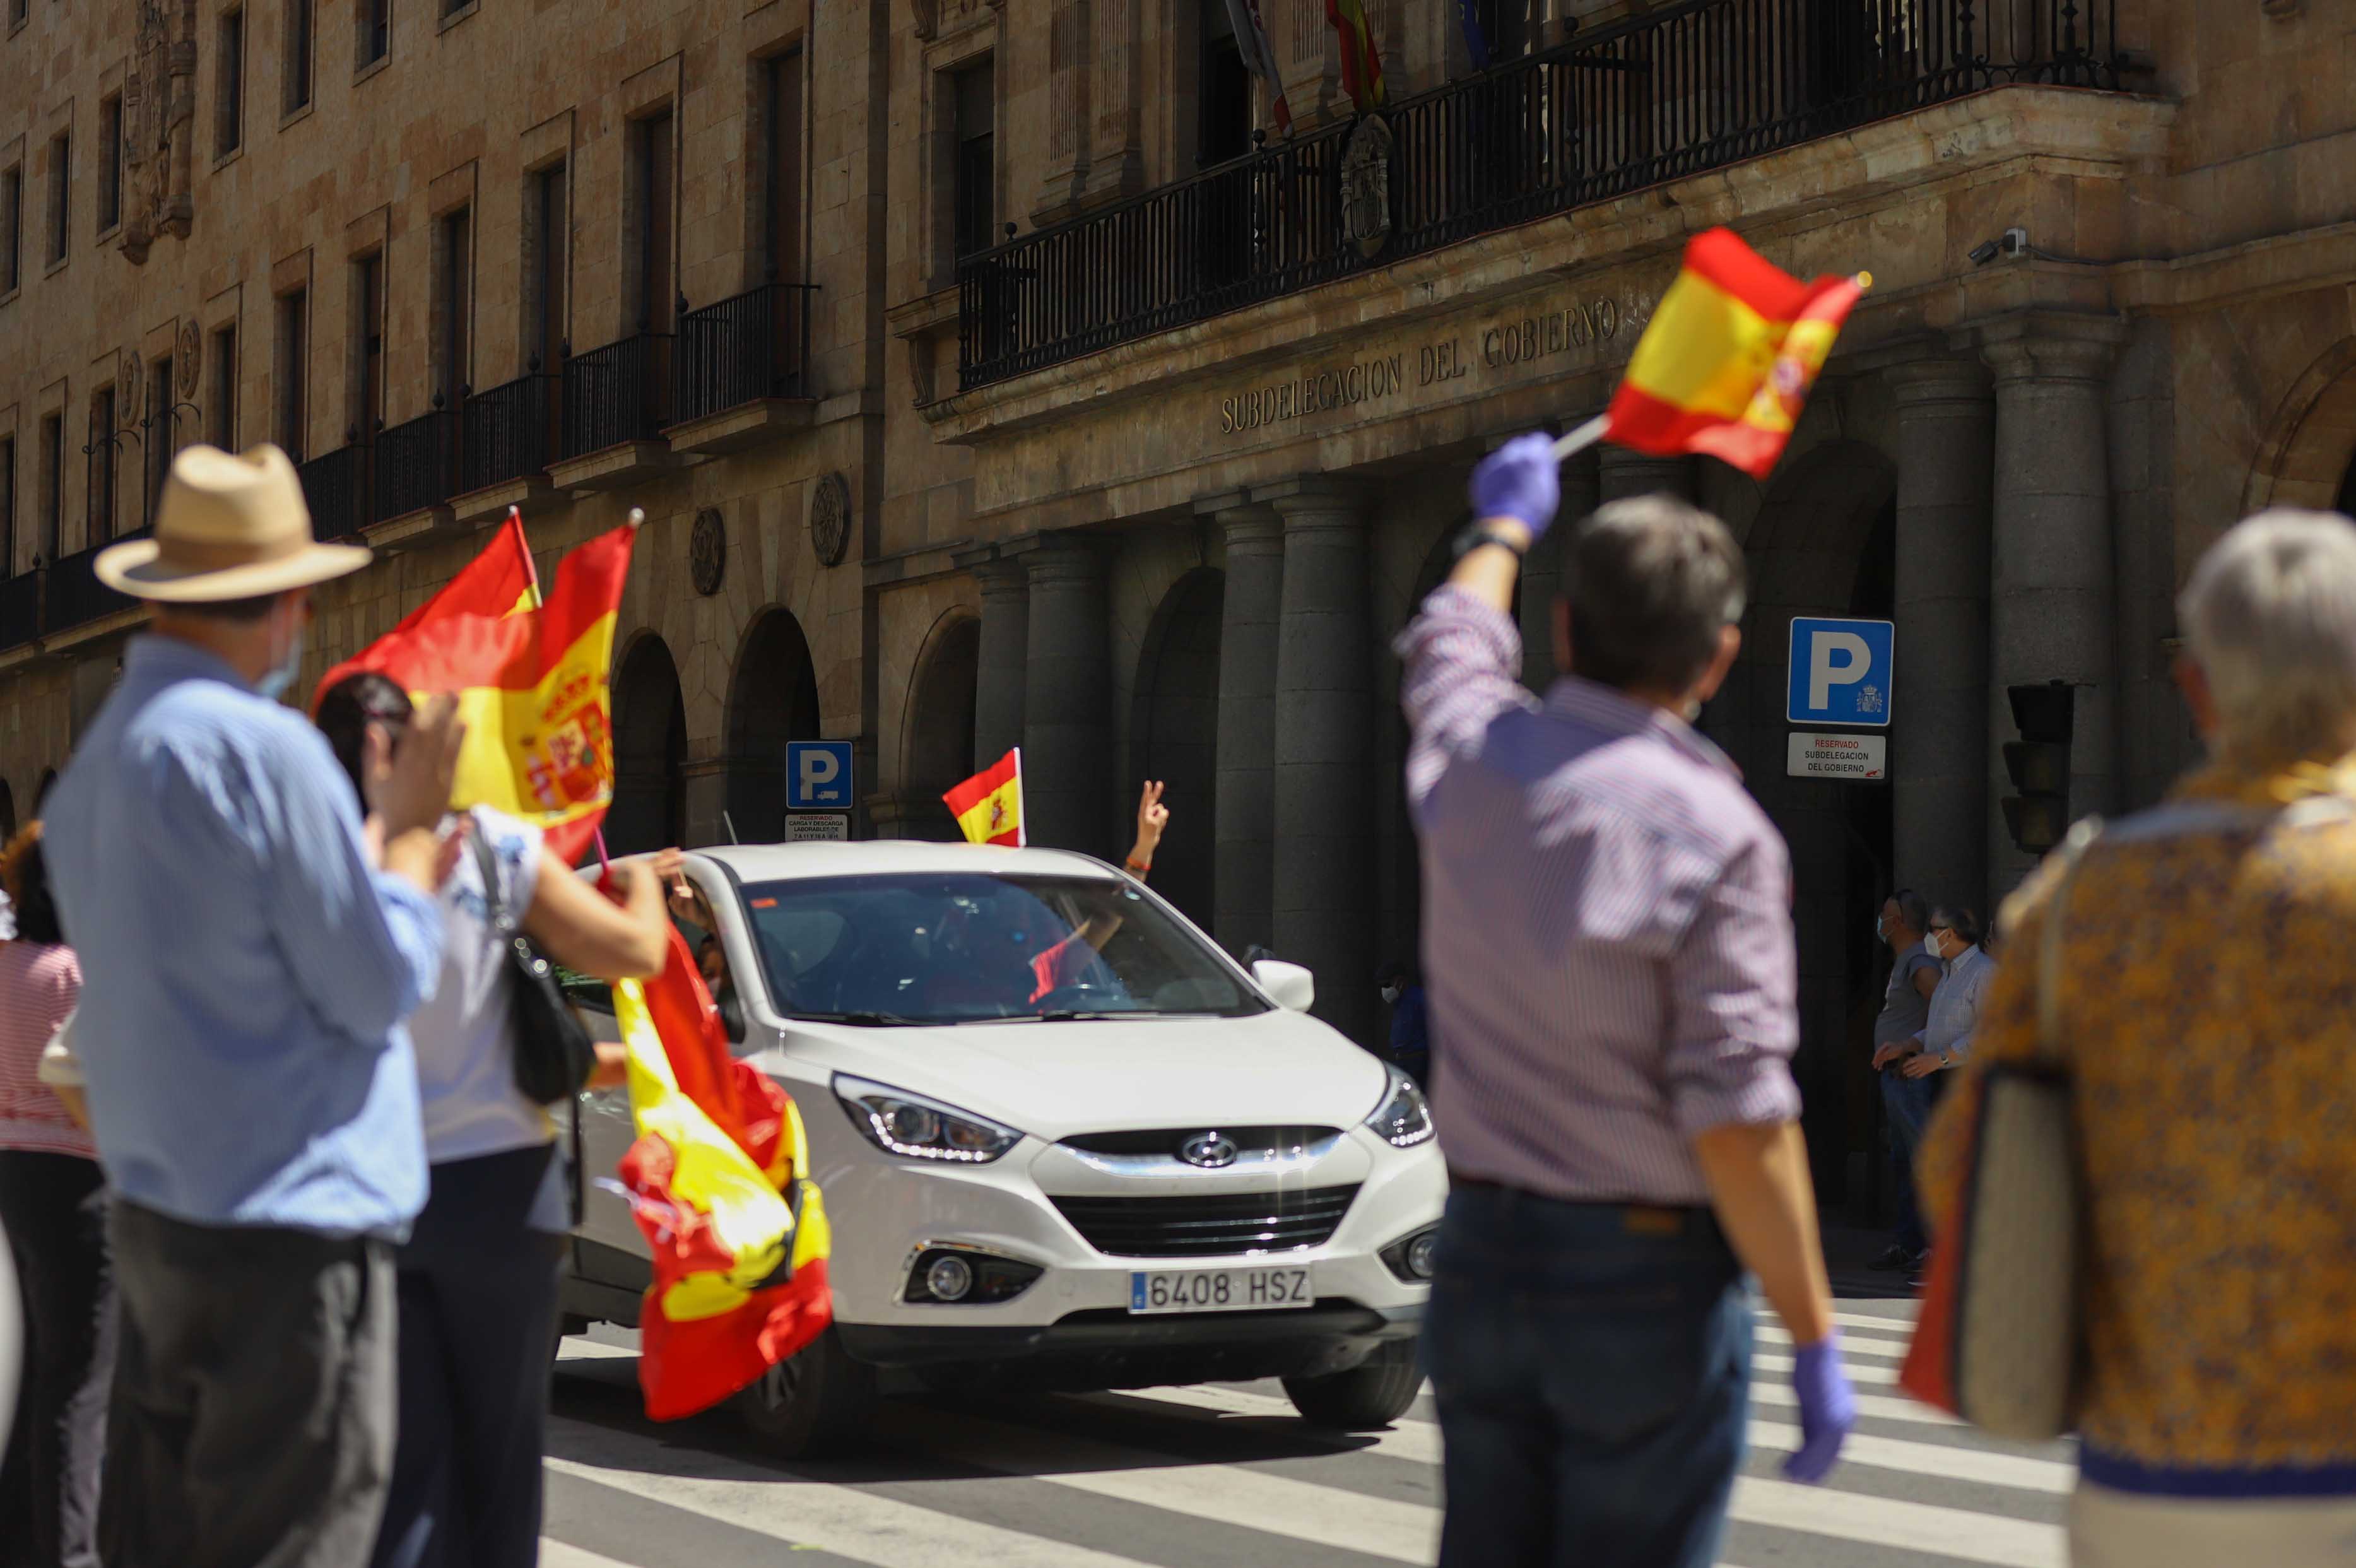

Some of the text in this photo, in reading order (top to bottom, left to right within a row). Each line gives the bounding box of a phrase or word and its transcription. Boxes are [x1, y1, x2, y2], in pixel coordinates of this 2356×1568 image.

[1222, 297, 1618, 434] SUBDELEGACION DEL GOBIERNO
[1808, 631, 1871, 710] P
[1805, 751, 1868, 760] SUBDELEGACION
[1815, 739, 1859, 749] RESERVADO
[799, 750, 839, 800] P
[1808, 763, 1822, 771] DEL
[1825, 763, 1864, 773] GOBIERNO
[1150, 1271, 1307, 1306] 6408 HSZ
